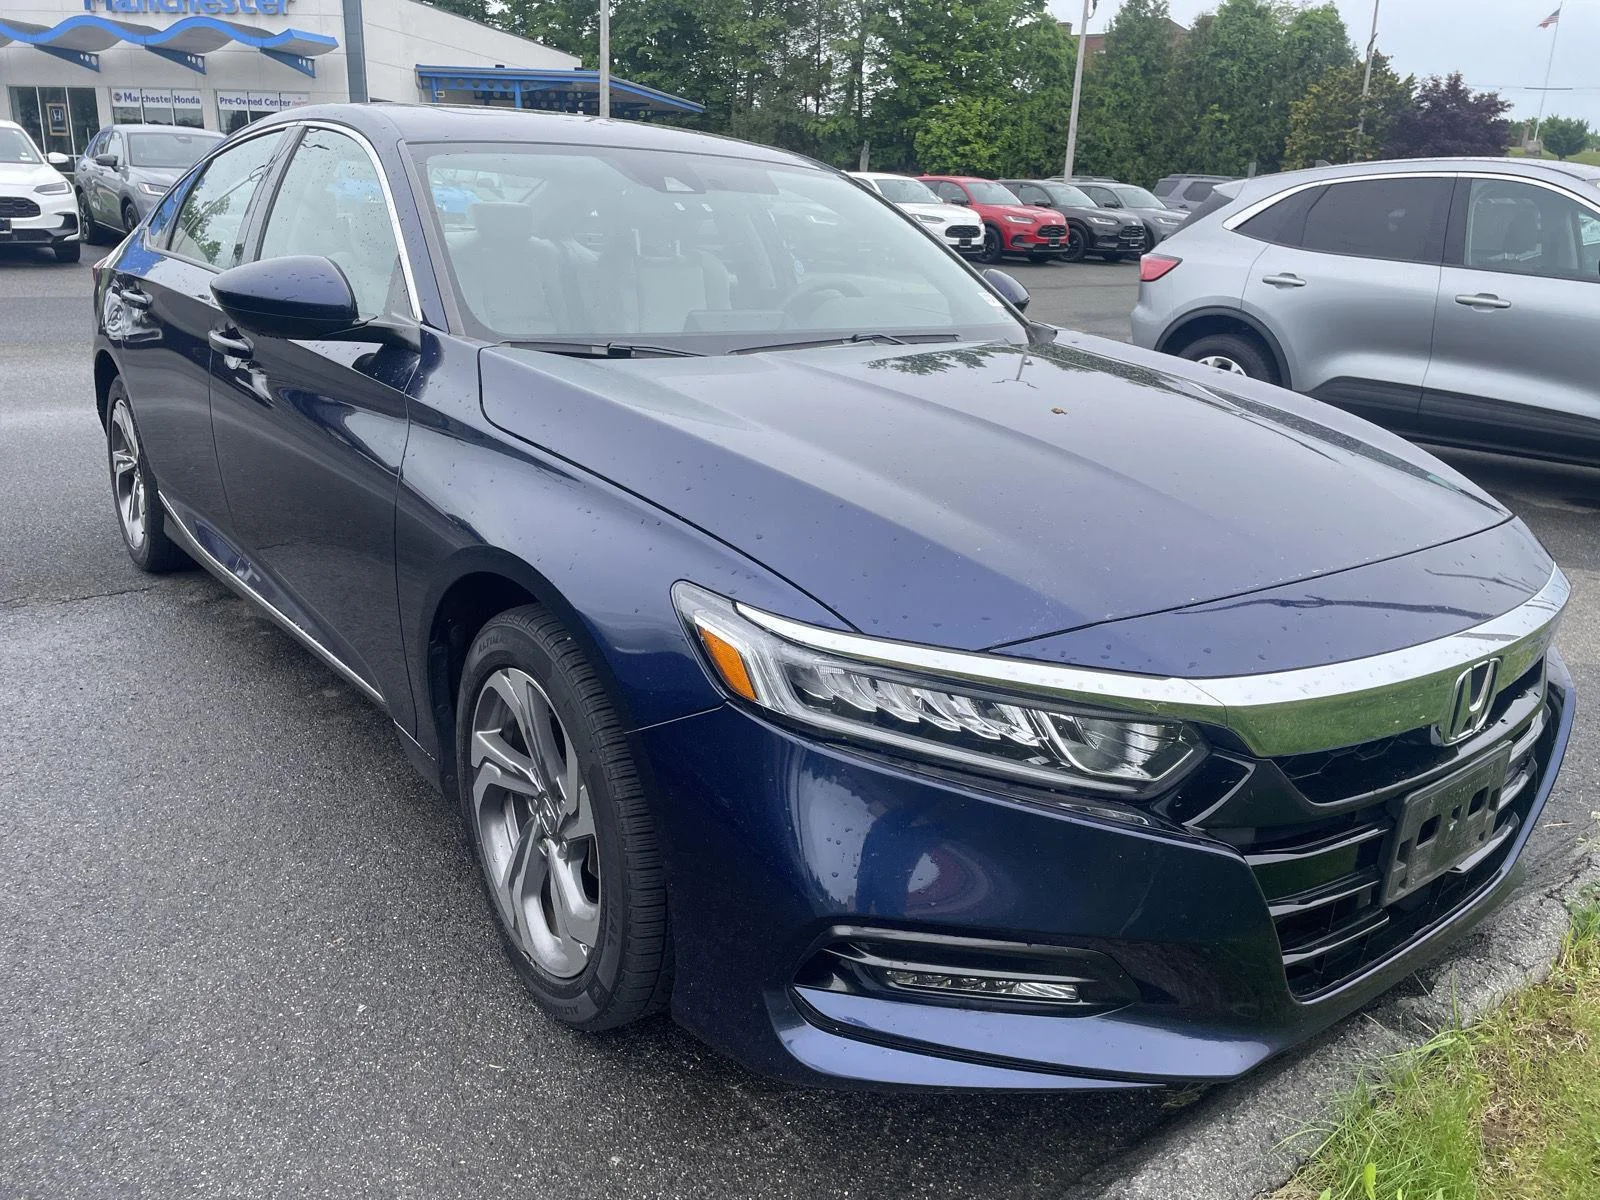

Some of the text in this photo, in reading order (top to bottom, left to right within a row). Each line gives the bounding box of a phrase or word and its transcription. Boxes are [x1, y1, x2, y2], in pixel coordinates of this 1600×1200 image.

[174, 95, 201, 104] Honda
[219, 96, 263, 106] Pre-Owned
[264, 98, 291, 107] Center
